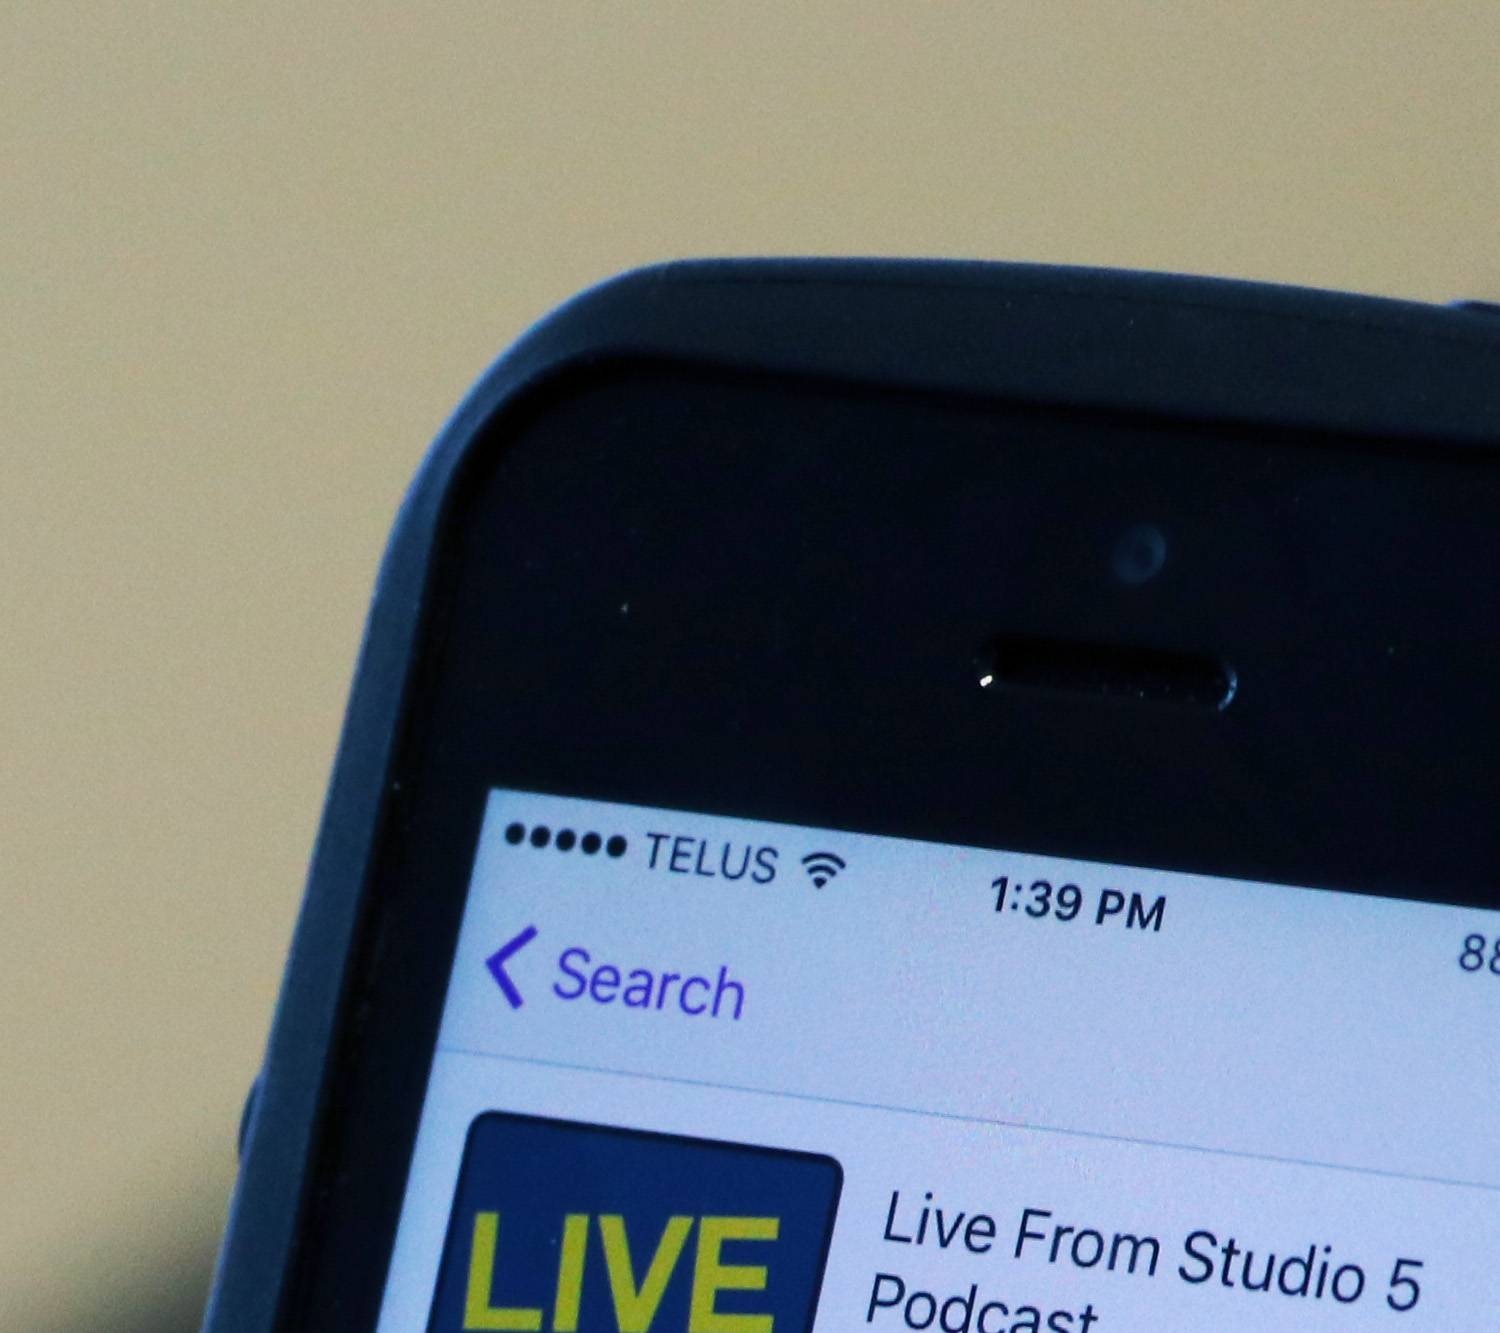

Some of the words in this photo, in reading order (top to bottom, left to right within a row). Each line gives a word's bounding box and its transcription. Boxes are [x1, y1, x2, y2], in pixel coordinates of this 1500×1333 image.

[645, 830, 780, 886] TELUS
[990, 875, 1084, 923] 1:39
[1094, 887, 1168, 933] PM
[551, 946, 746, 1021] Search
[882, 1189, 997, 1255] Live
[1013, 1207, 1161, 1278] From
[1177, 1229, 1366, 1305] Studio
[1385, 1256, 1425, 1314] 5
